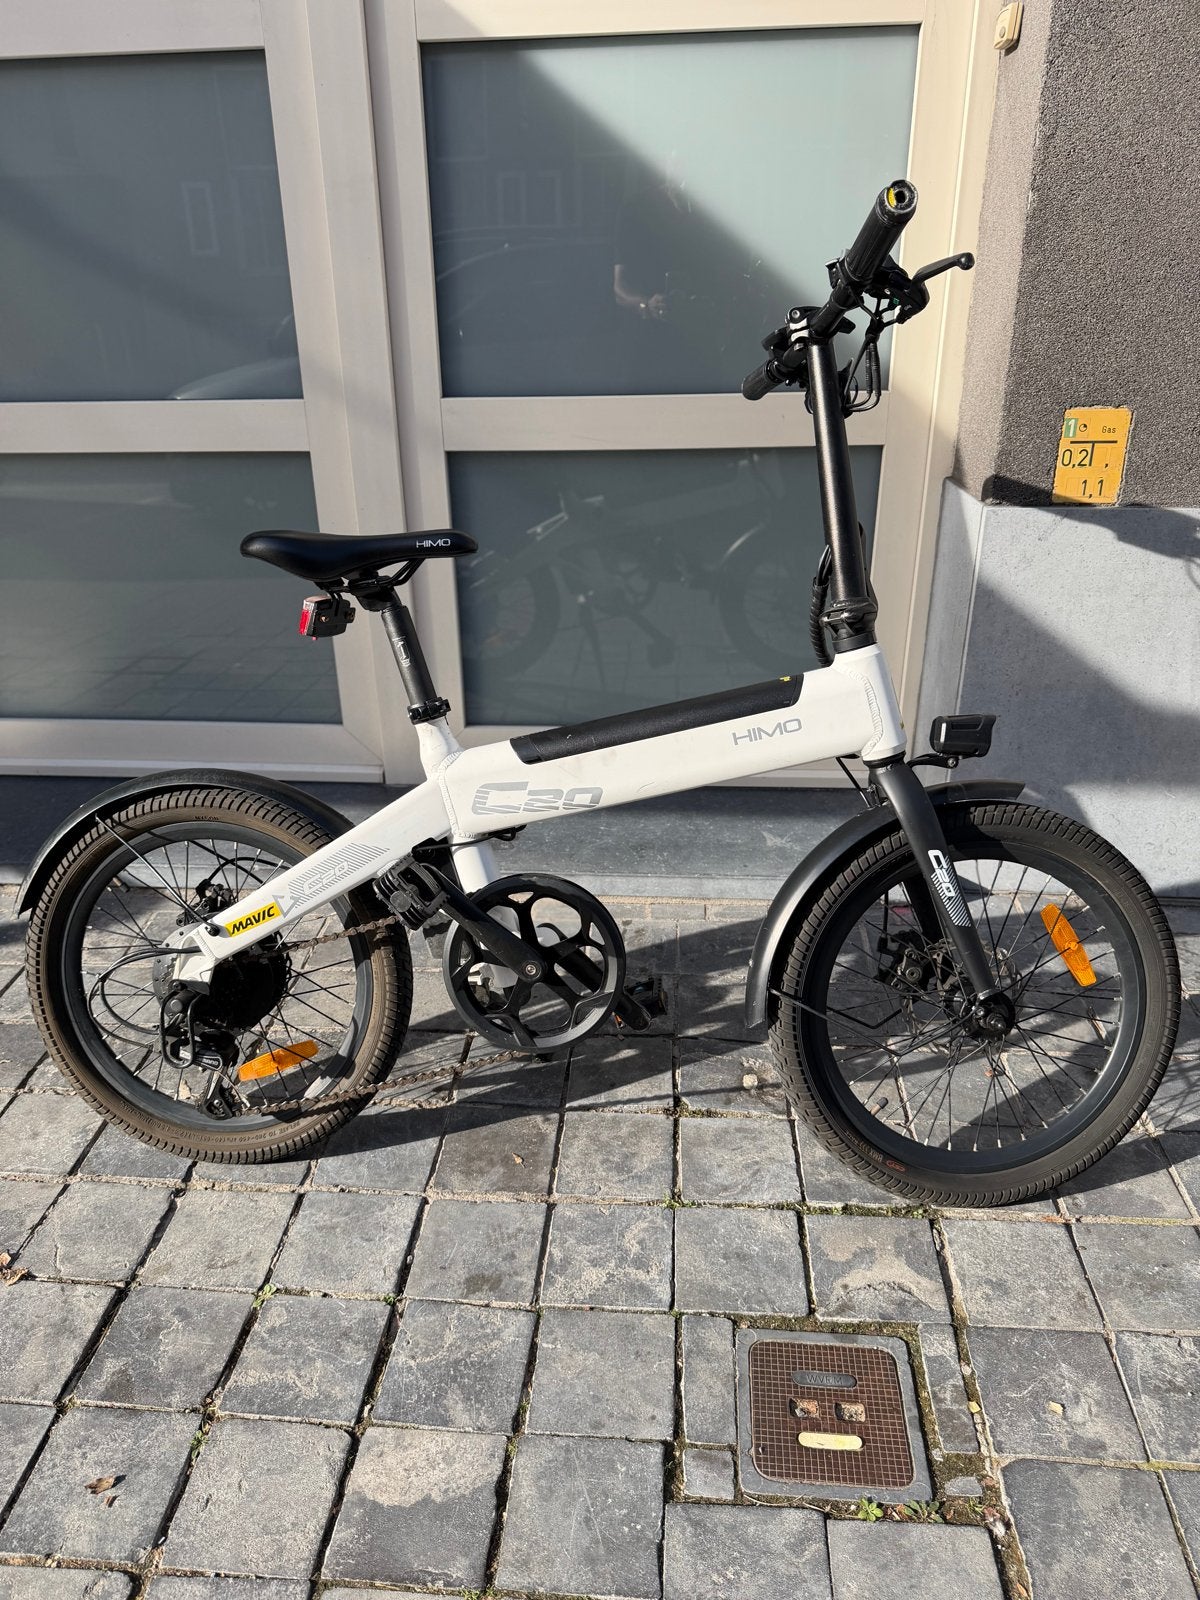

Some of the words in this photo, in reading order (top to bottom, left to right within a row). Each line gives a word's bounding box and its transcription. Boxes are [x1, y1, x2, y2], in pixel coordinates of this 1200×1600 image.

[1101, 425, 1117, 434] Gas
[1061, 448, 1089, 469] 0,2
[1081, 479, 1104, 499] 1,1
[416, 538, 451, 549] HIMO
[731, 717, 803, 747] HIMO
[471, 780, 604, 816] C20
[230, 904, 276, 935] MAVIC
